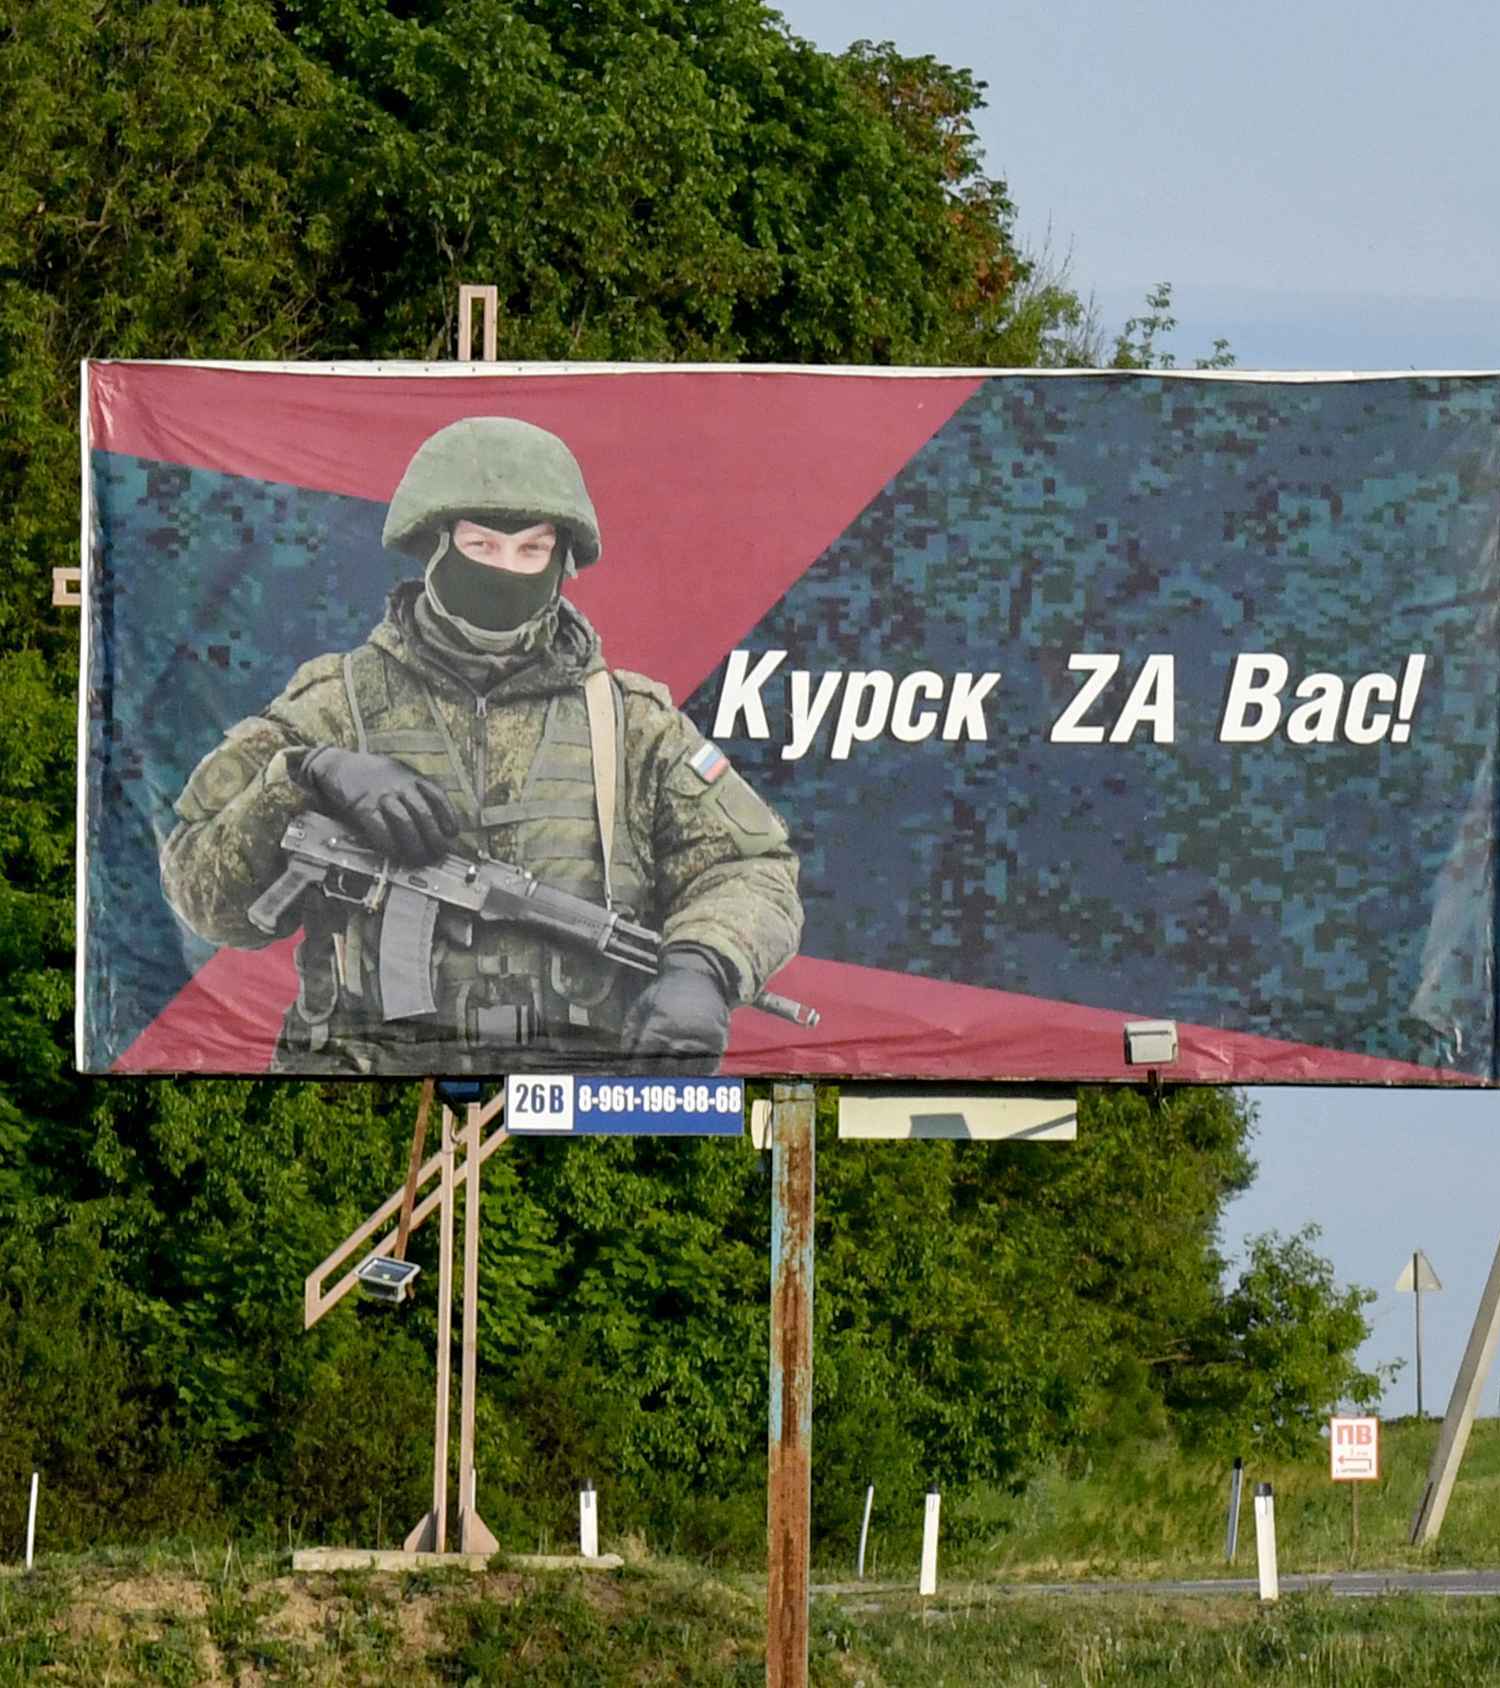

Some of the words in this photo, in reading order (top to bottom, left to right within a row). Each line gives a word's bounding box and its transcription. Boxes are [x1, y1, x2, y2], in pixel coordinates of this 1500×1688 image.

[712, 649, 1001, 760] Курск
[1050, 653, 1177, 744] ZA
[1219, 653, 1427, 745] Вас!
[1336, 1424, 1373, 1446] ПВ
